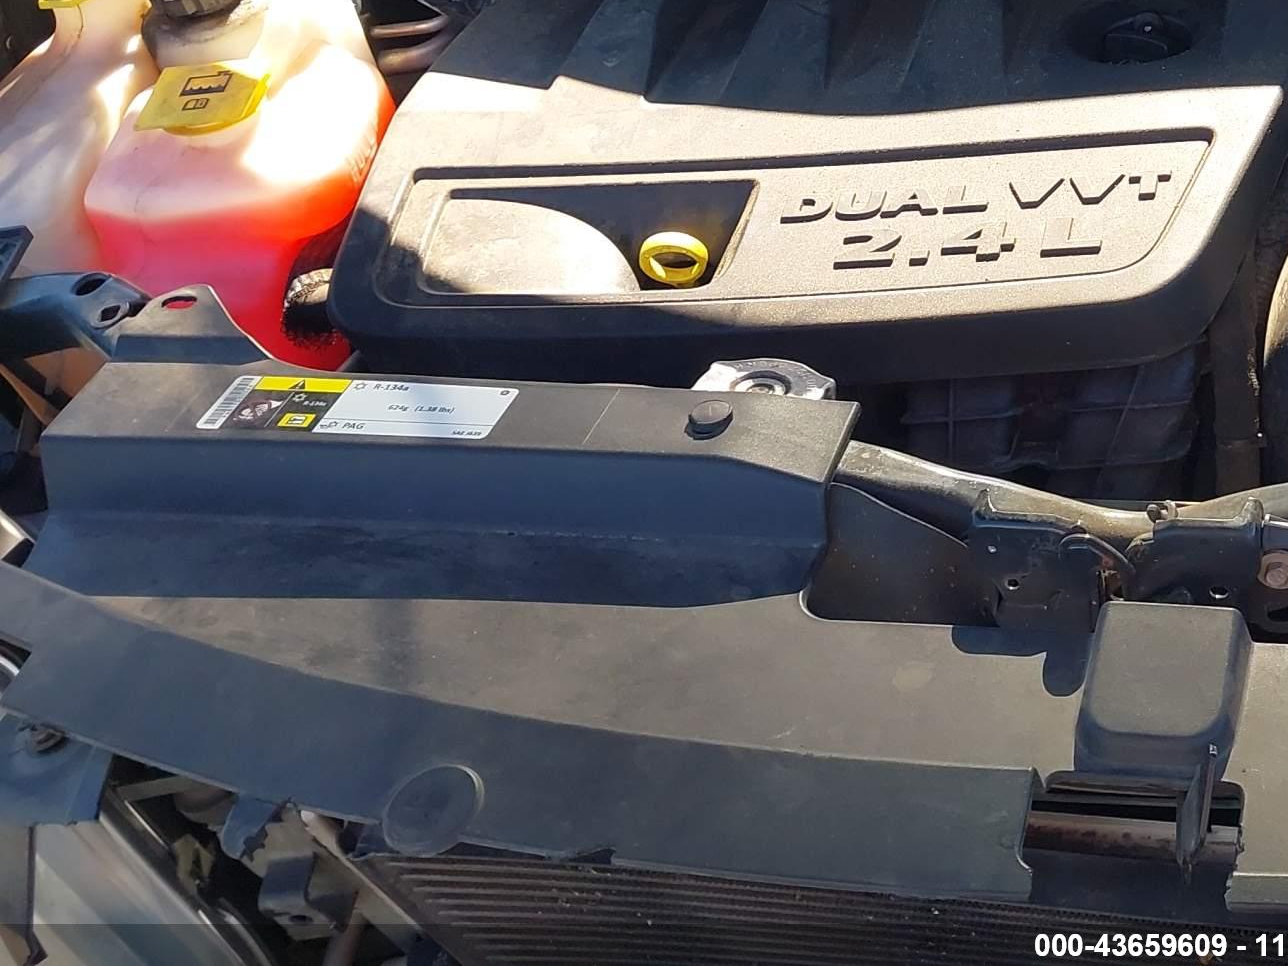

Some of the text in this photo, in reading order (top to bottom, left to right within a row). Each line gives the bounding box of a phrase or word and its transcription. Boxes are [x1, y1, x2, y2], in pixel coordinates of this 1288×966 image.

[779, 170, 1172, 224] DUAL VVT
[373, 384, 410, 392] R-134a
[342, 421, 365, 430] PAG
